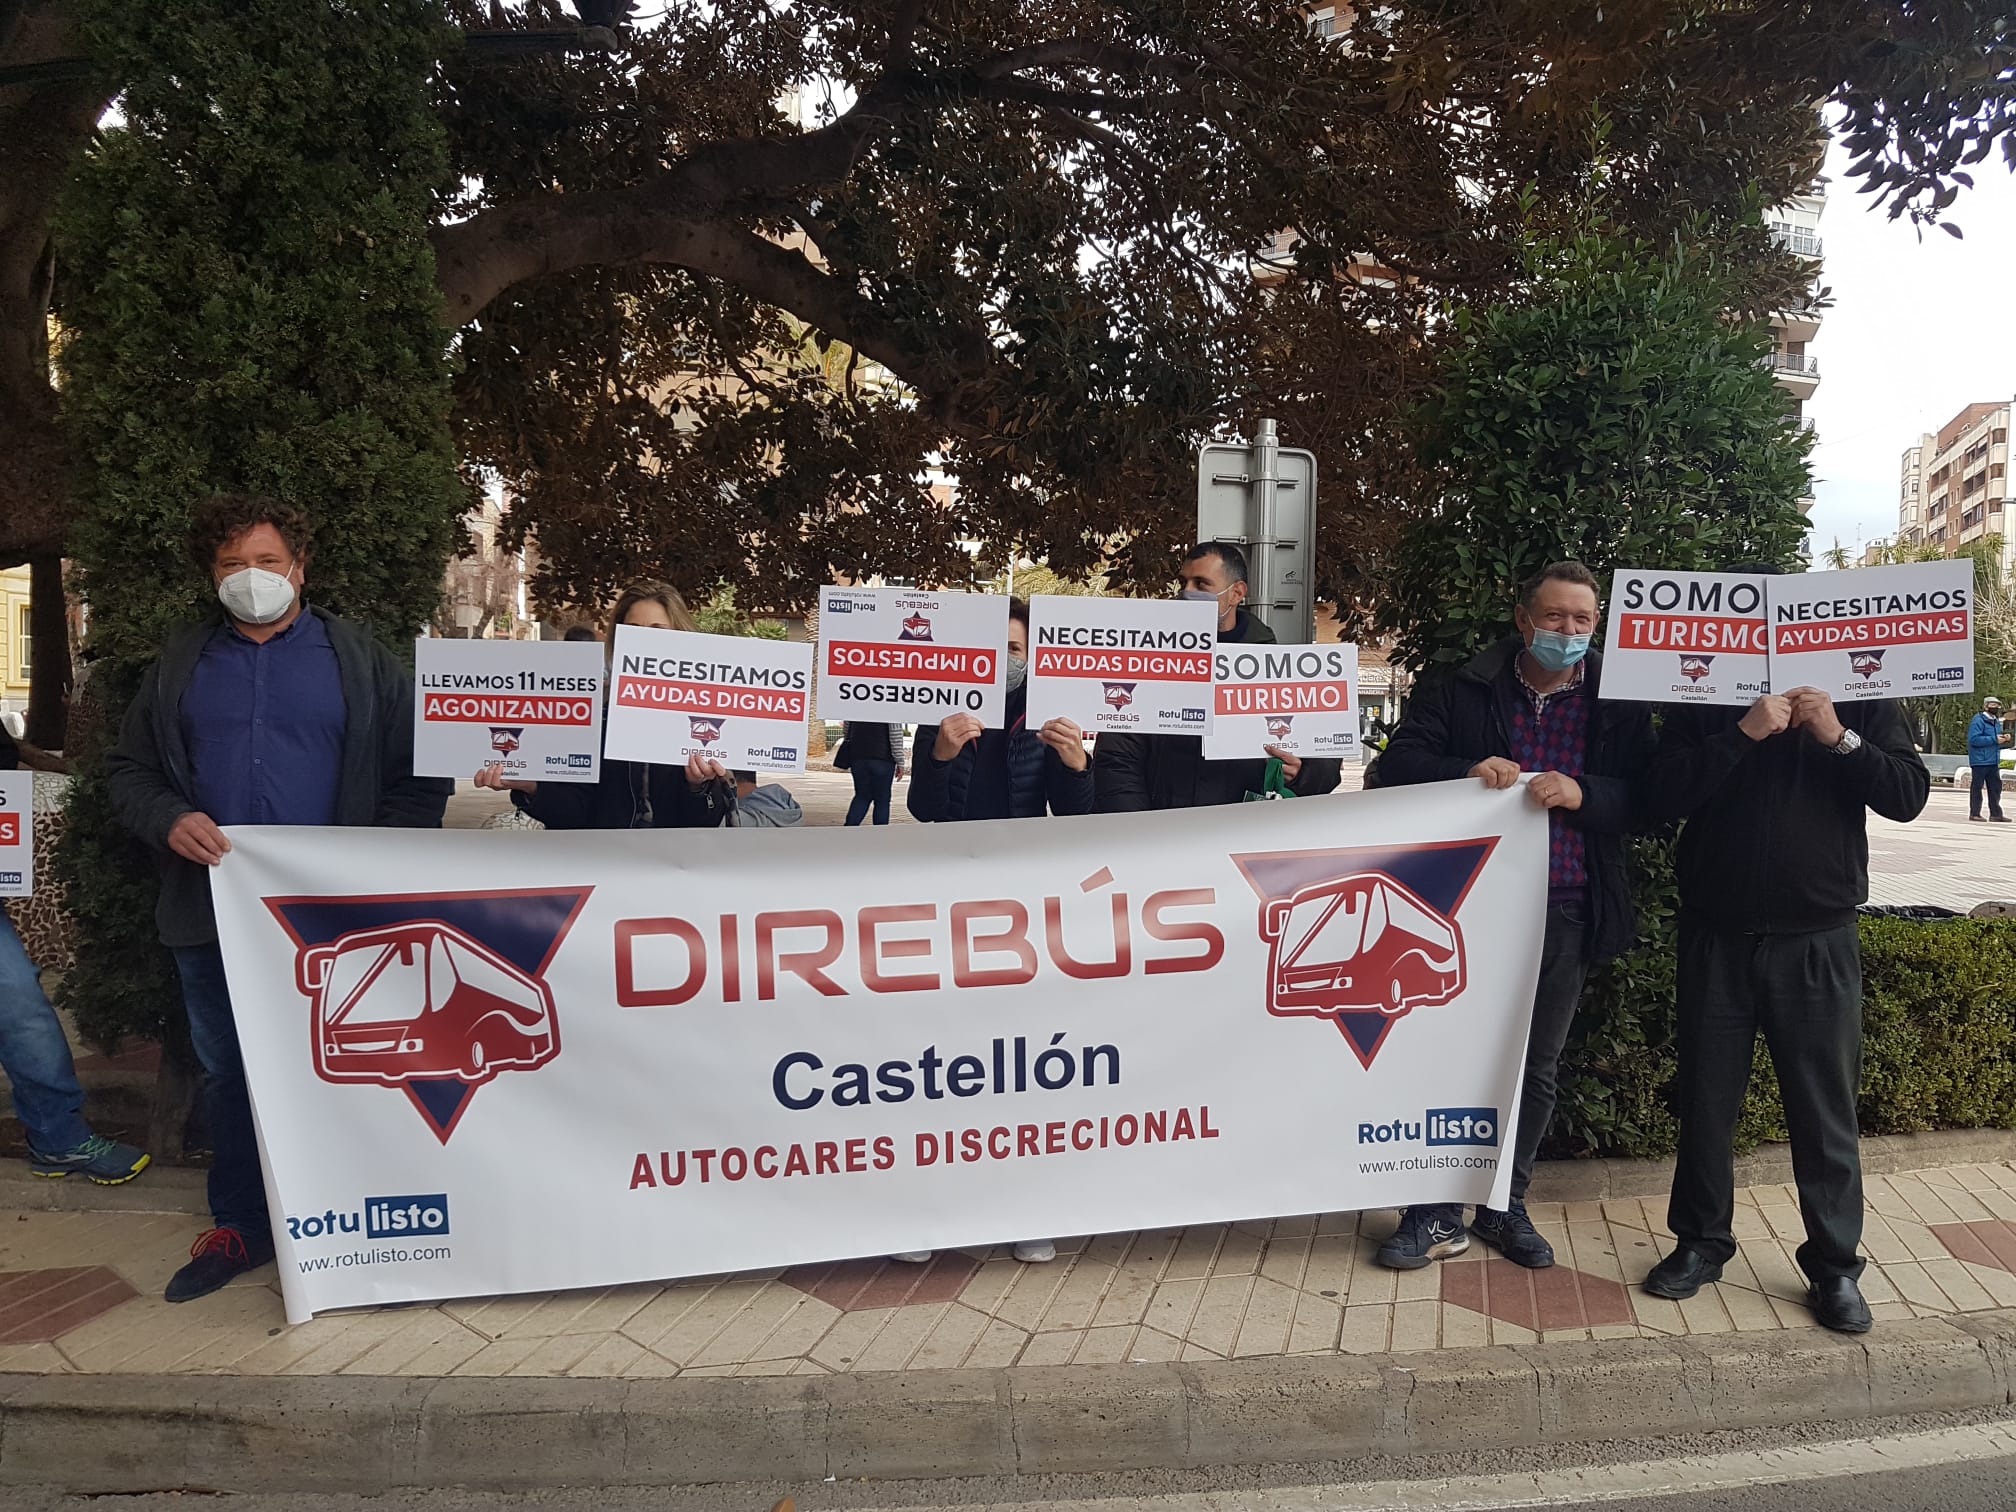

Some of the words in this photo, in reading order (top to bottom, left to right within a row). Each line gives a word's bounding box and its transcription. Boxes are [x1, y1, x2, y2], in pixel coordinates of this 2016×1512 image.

[830, 602, 852, 612] listo
[854, 602, 876, 612] Rotu
[895, 600, 939, 610] DIREBÚS
[1623, 579, 1769, 614] SOMO
[1777, 589, 1967, 623] NECESITAMOS
[1038, 626, 1212, 651] NECESITAMOS
[1632, 619, 1769, 651] TURISMO
[1779, 625, 1869, 647] AYUDAS
[1875, 617, 1965, 640] DIGNAS
[833, 648, 967, 673] IMPUESTOS
[1039, 653, 1123, 672] AYUDAS
[1128, 656, 1209, 675] DIGNAS
[1215, 651, 1343, 681] SOMOS
[422, 674, 515, 690] LLEVAMOS
[518, 672, 536, 691] 11
[540, 677, 597, 692] MESES
[622, 654, 807, 690] NECESITAMOS
[1912, 672, 1936, 681] Rotu
[1938, 669, 1962, 680] listo
[839, 683, 959, 706] INGRESOS
[1671, 684, 1717, 694] DIREBÚS
[1736, 683, 1760, 692] Rotu
[1844, 680, 1892, 692] DIREBÚS
[1912, 682, 1964, 691] www.rotulisto.com
[426, 698, 591, 721] AGONIZANDO
[620, 683, 711, 707] AYUDAS
[716, 691, 802, 714] DIGNAS
[1223, 686, 1341, 711] TURISMO
[1096, 712, 1140, 723] DIREBÚS
[1158, 710, 1181, 719] Rotu
[1182, 710, 1205, 720] listo
[1334, 735, 1352, 744] listo
[545, 756, 568, 765] Rotu
[569, 754, 591, 767] listo
[748, 748, 771, 758] Rotu
[773, 749, 796, 760] listo
[747, 761, 797, 770] www.rotulisto.com
[614, 865, 1225, 1008] DIREBÚS
[772, 1032, 1121, 1111] Castellón
[1358, 1119, 1421, 1144] Rotu
[1431, 1114, 1494, 1140] listo
[629, 1135, 895, 1190] AUTOCARES
[916, 1105, 1220, 1167] DISCRECIONAL
[1359, 1155, 1498, 1174] www.rotulisto.com
[286, 1209, 360, 1240] Rotu
[371, 1203, 444, 1232] listo
